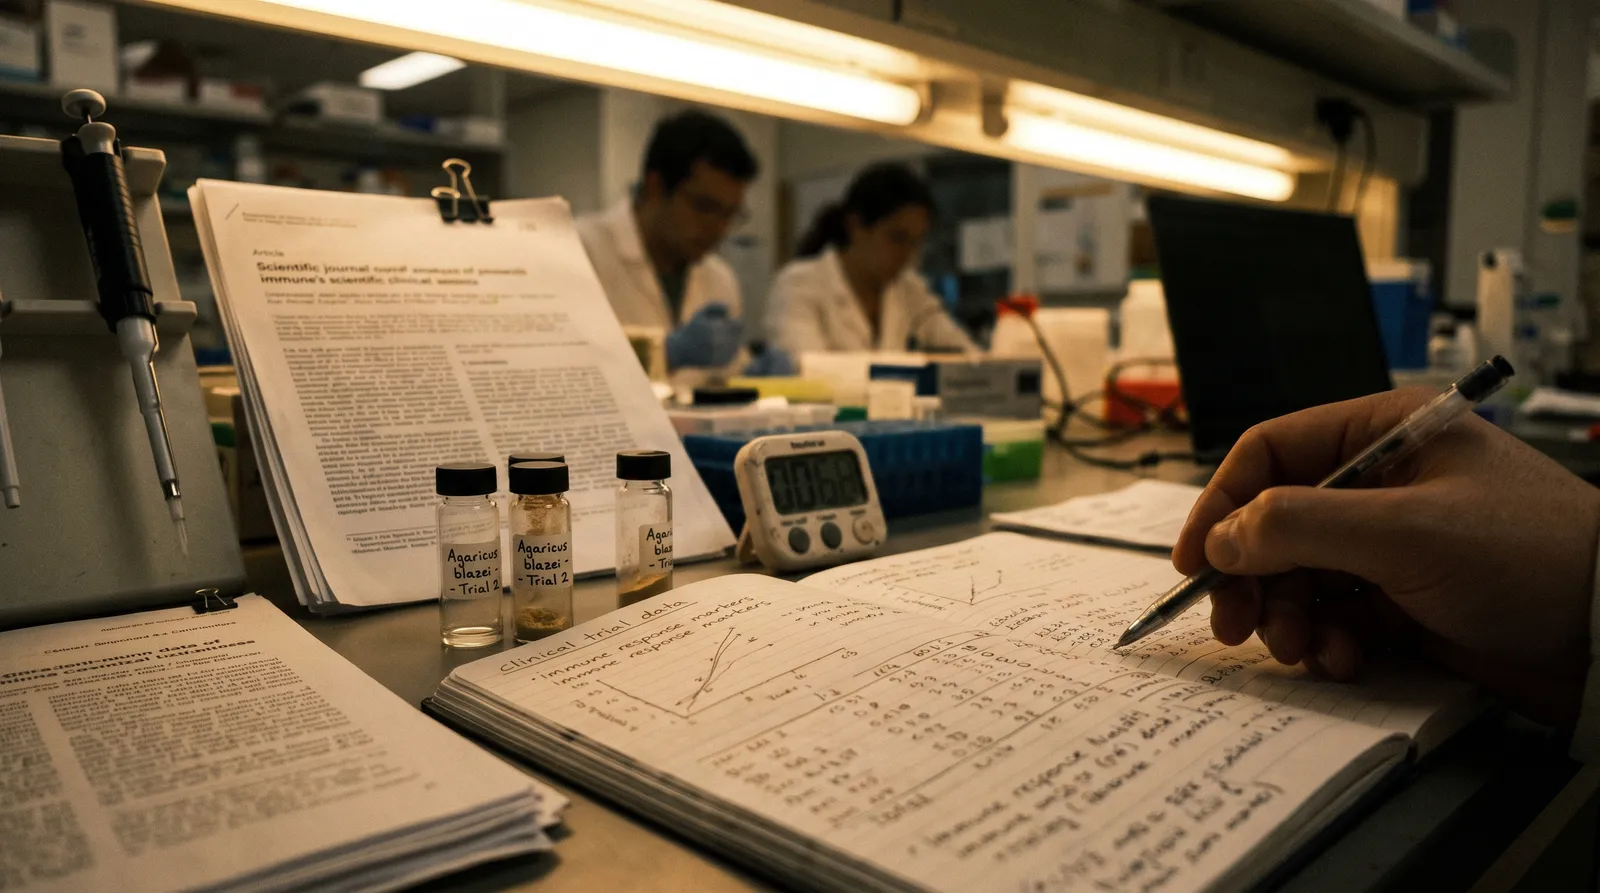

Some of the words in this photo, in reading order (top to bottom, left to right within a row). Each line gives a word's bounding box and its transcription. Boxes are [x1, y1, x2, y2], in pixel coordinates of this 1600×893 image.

[257, 261, 320, 273] Scientific
[324, 264, 370, 275] journal
[260, 274, 326, 284] immune's
[329, 275, 386, 285] scientific
[518, 540, 568, 559] Agaricus
[447, 548, 498, 568] Agaricus
[524, 558, 561, 571] blazei
[453, 566, 491, 579] blazei
[526, 573, 557, 586] Trial
[561, 571, 569, 583] 2
[458, 580, 490, 595] Trial
[493, 579, 500, 591] 2
[583, 618, 631, 641] trial
[641, 600, 689, 621] data
[540, 651, 613, 679] immune
[618, 622, 685, 651] response
[691, 596, 755, 622] markers
[629, 629, 695, 658] response
[702, 601, 772, 628] markers
